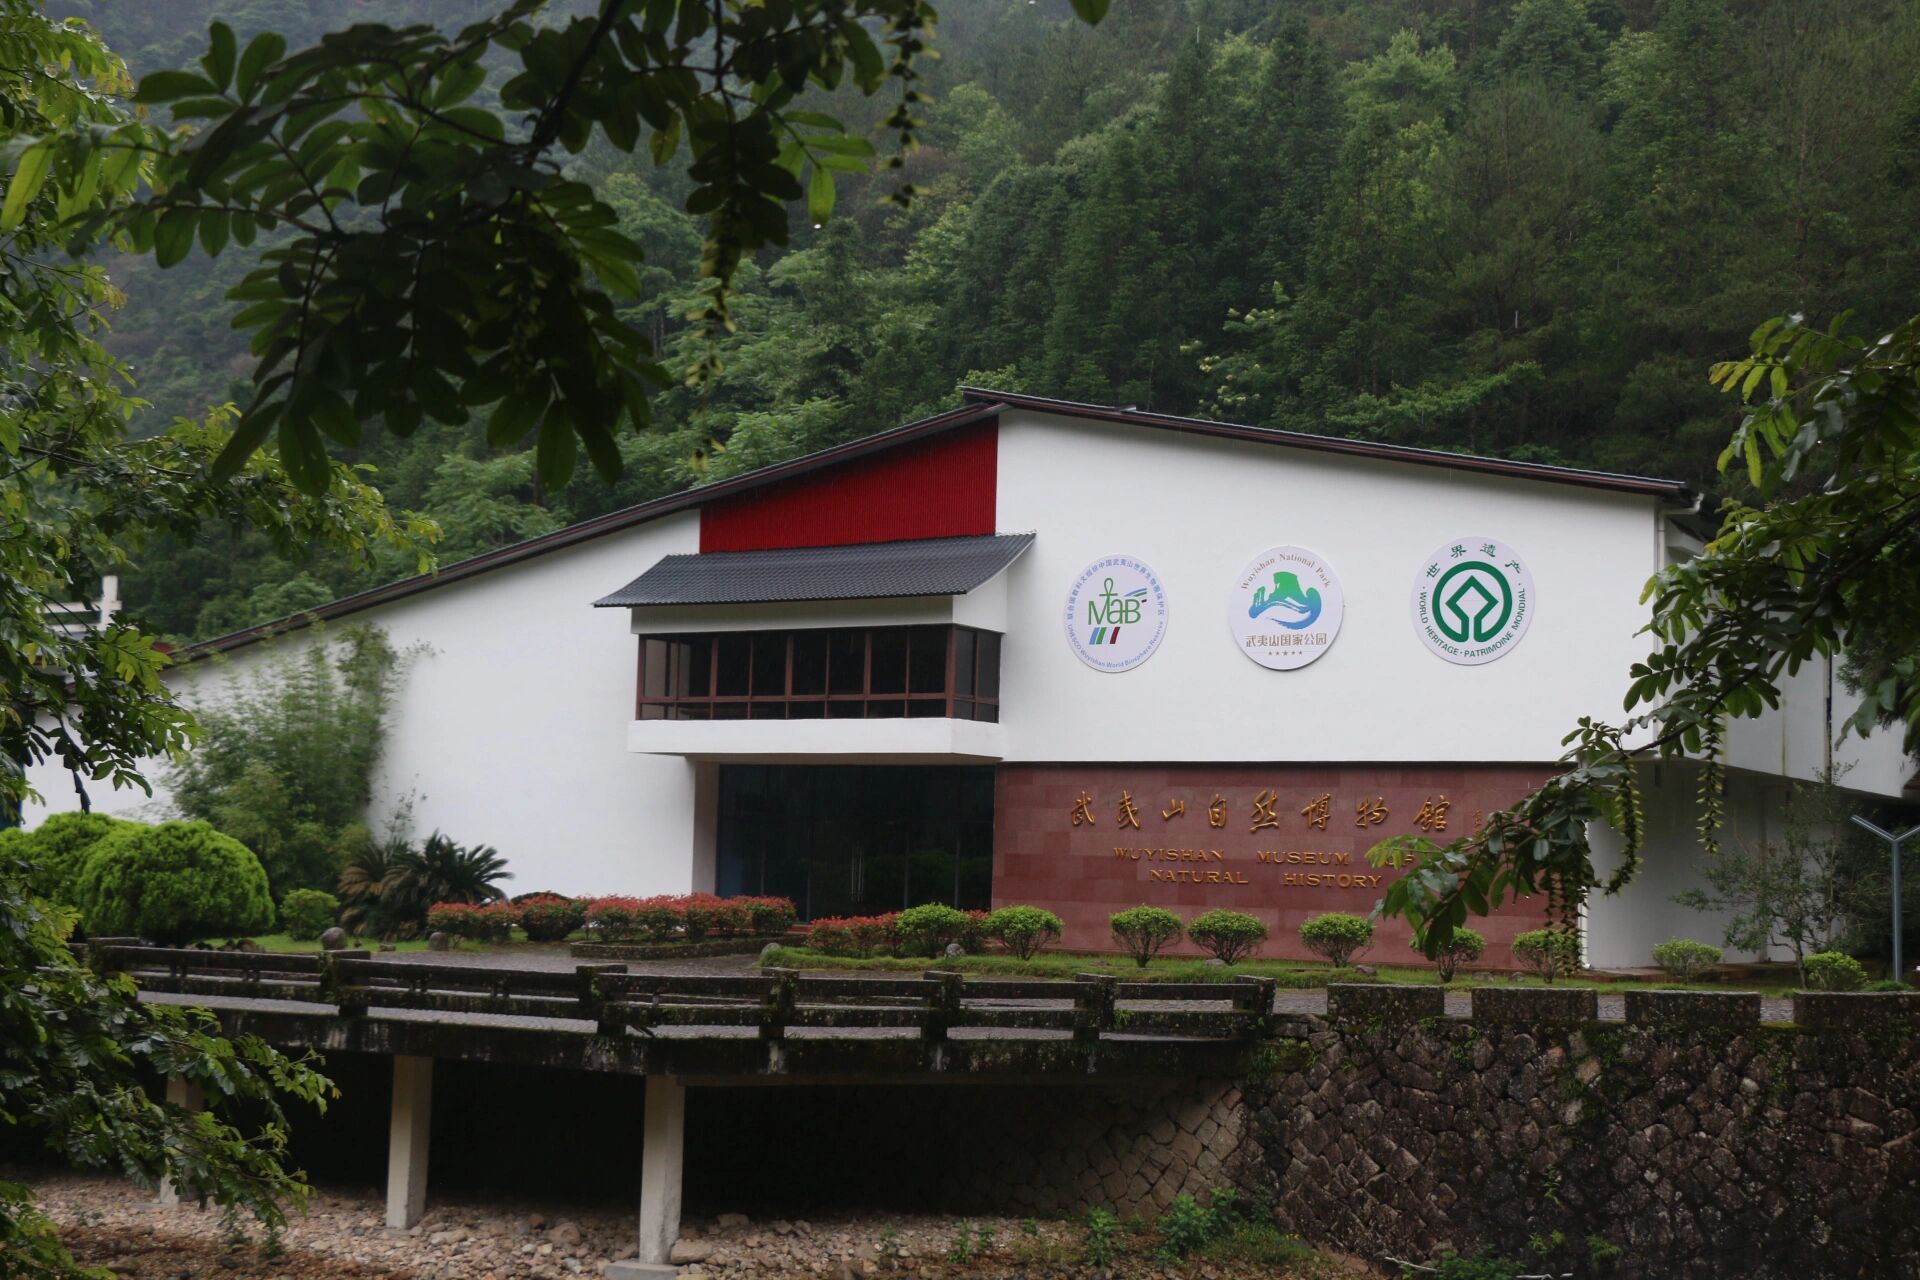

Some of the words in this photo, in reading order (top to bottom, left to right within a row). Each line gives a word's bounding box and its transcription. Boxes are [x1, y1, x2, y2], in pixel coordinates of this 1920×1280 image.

[1241, 558, 1275, 589] Wuyishan
[1279, 553, 1315, 568] National
[1315, 567, 1331, 588] Park
[1419, 591, 1429, 624] WORLD
[1425, 625, 1460, 656] HERITAGE
[1464, 631, 1514, 657] PATRIMOINE
[1511, 588, 1526, 630] MONDIAL
[1246, 633, 1327, 648] 武夷山国家公园
[1113, 848, 1224, 863] WUYISHAN
[1257, 850, 1349, 865] MUSEUM
[1150, 869, 1249, 884] NATURAL
[1283, 873, 1382, 888] HISTORY
